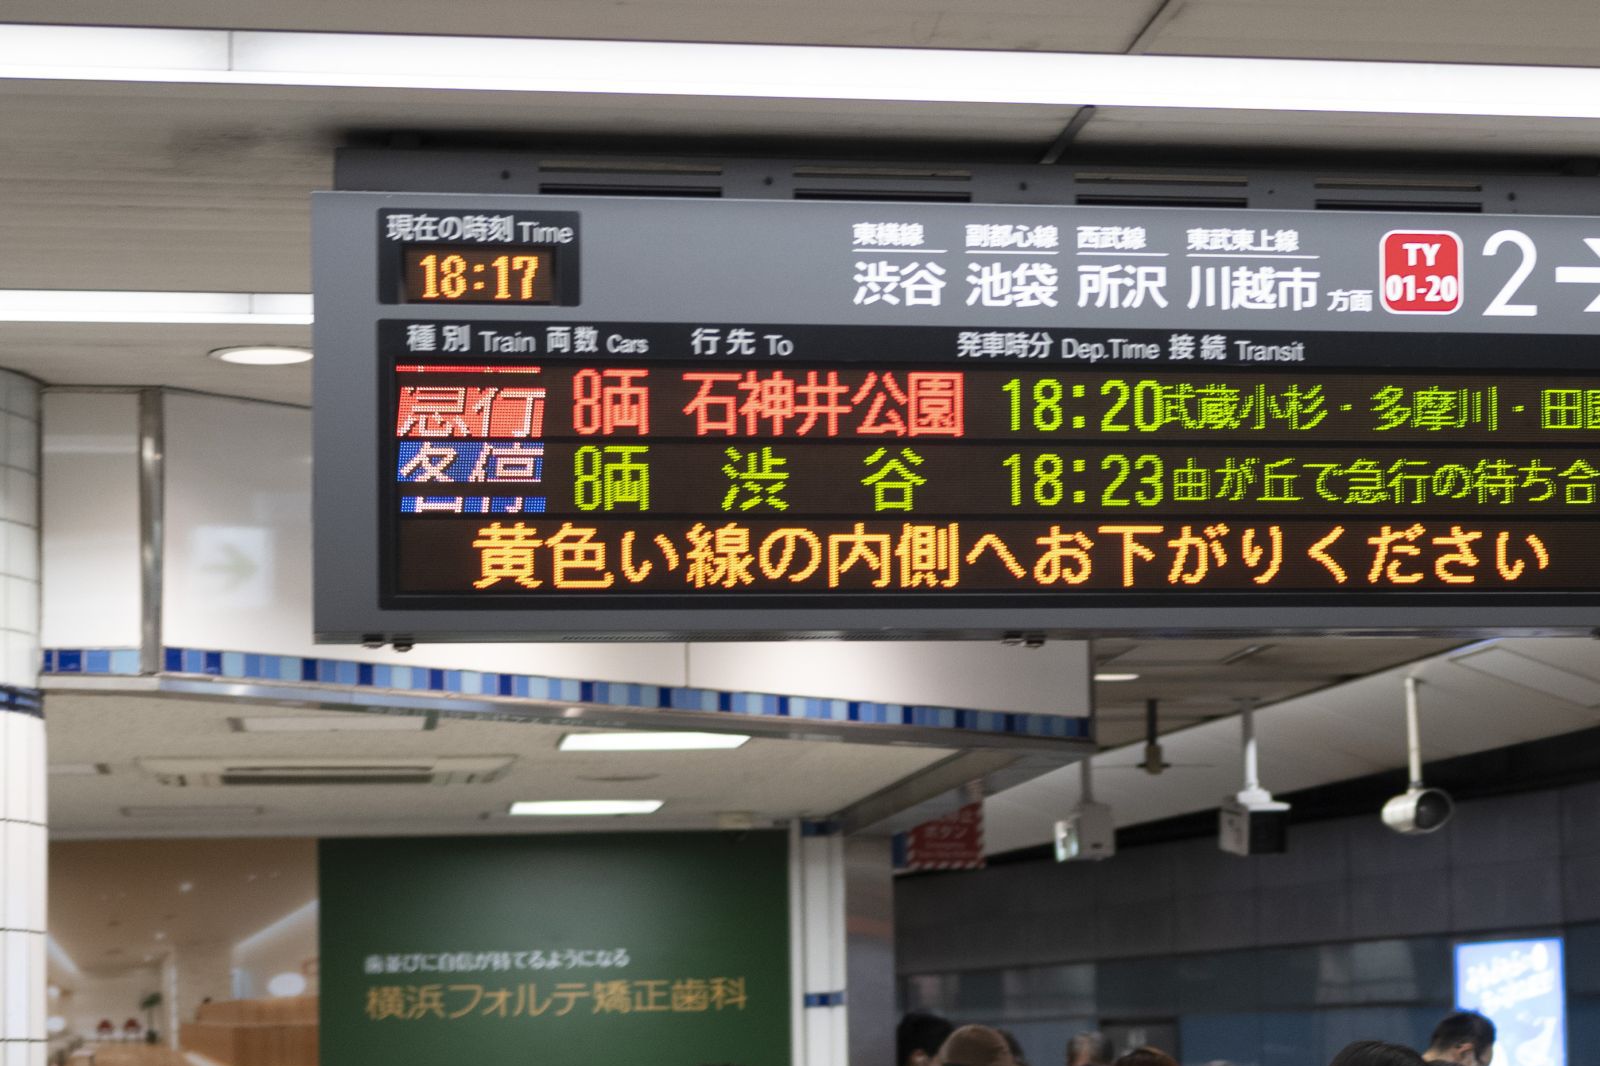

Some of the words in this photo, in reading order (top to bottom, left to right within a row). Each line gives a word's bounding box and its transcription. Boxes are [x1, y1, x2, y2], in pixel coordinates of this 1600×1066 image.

[387, 214, 513, 243] 現在の時刻
[517, 222, 573, 243] Time
[853, 223, 924, 247] 東横線
[965, 224, 1058, 248] 副都心線
[1077, 226, 1146, 250] 西武線
[1186, 228, 1299, 253] 東武東上線
[1402, 243, 1441, 266] TY
[419, 254, 539, 299] 18:17
[853, 260, 947, 306] 渋谷
[965, 261, 1058, 308] 池袋
[1077, 264, 1168, 309] 所沢
[1186, 265, 1320, 311] 川越市
[1327, 289, 1373, 312] 方面
[1482, 230, 1537, 316] 2
[1385, 275, 1457, 302] 01-20
[407, 324, 470, 352] 種別
[479, 332, 536, 352] Train
[547, 326, 598, 353] 両数
[606, 334, 648, 354] Cars
[691, 328, 755, 355] 行先
[763, 336, 793, 356] To
[957, 332, 1053, 359] 発車時分
[1061, 339, 1159, 362] Dep.Time
[1169, 334, 1226, 361] 接続
[1235, 341, 1304, 362] Transit
[398, 366, 546, 437] 急行
[573, 369, 649, 435] 8両
[682, 371, 964, 436] 石神井公園
[1003, 379, 1162, 432] 18:20
[574, 445, 649, 511] 8両
[1003, 453, 1164, 507] 18:23
[473, 523, 1550, 588] 黄色い線の内側へお下がりください
[364, 977, 747, 1021] 横浜フォルテ矯正歯科
